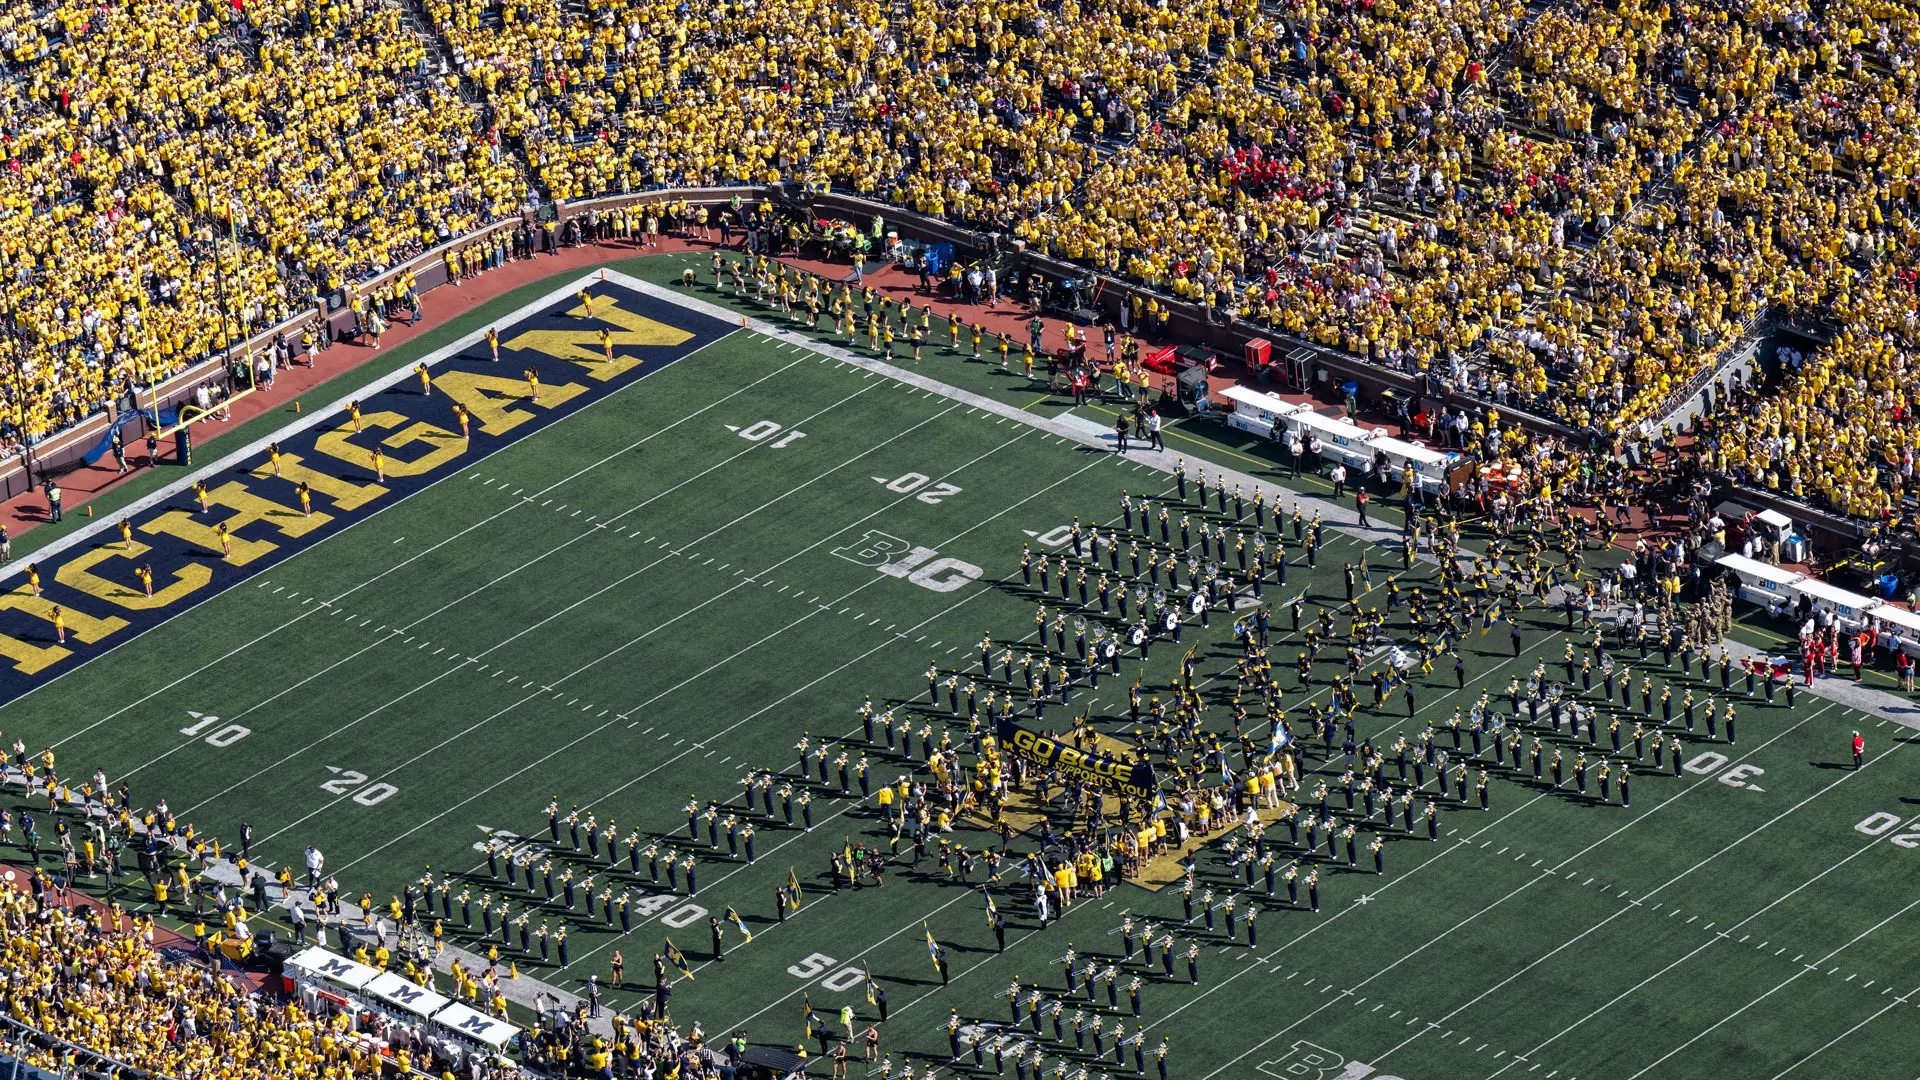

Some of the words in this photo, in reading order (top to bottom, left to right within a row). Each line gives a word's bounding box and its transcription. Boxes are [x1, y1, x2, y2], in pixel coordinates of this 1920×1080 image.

[179, 715, 252, 748] 10
[1002, 739, 1014, 752] M
[1019, 748, 1049, 766] CLUB
[1052, 761, 1113, 788] SUPPORTS
[1118, 781, 1148, 798] YOU
[1013, 729, 1056, 759] GO
[1059, 746, 1134, 783] BLUE
[319, 769, 399, 806] 20
[634, 894, 709, 929] 40
[317, 957, 354, 977] M
[787, 952, 869, 992] 50
[389, 984, 424, 1005] M
[459, 1014, 494, 1034] M
